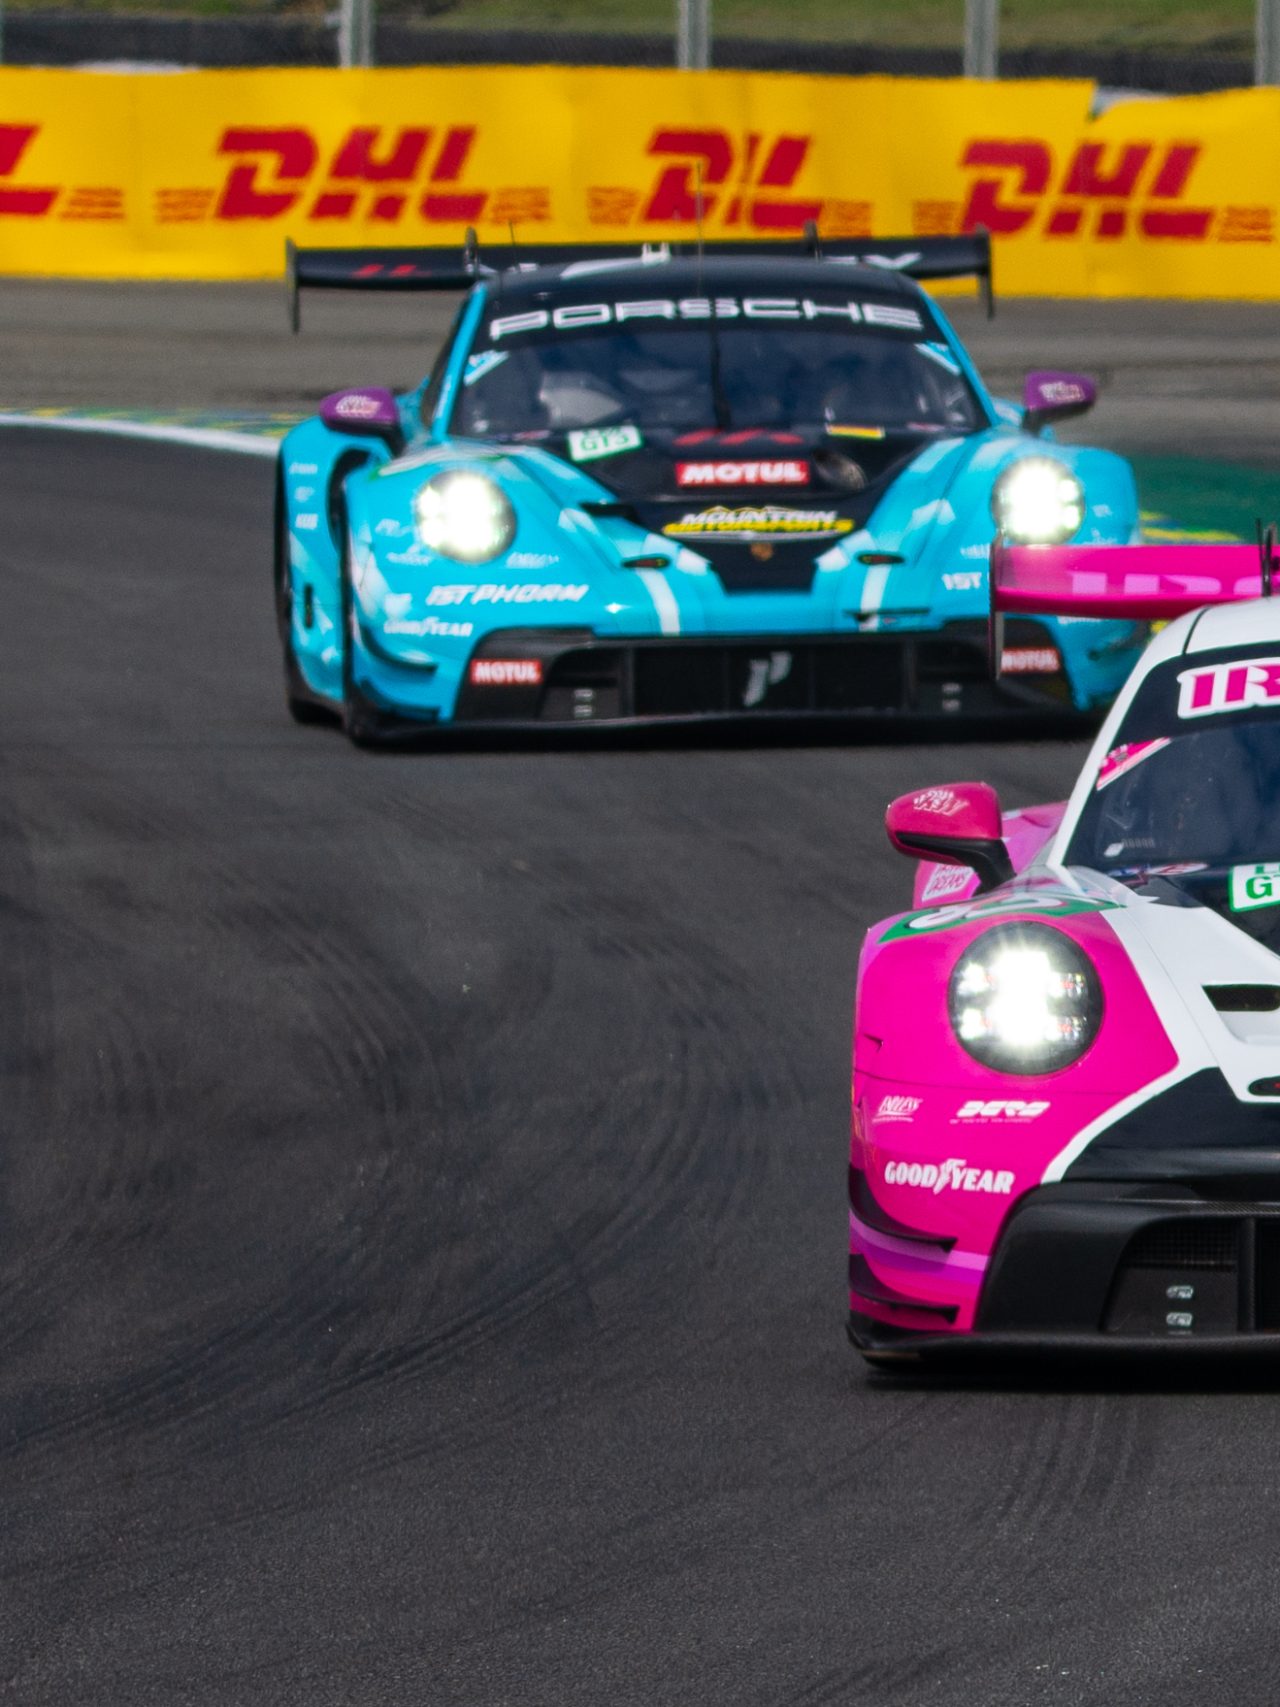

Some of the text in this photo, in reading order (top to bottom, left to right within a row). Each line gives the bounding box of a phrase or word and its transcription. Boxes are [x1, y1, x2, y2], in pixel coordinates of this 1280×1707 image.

[214, 125, 489, 222] DHL
[959, 138, 1213, 240] DHL
[490, 298, 923, 341] PORSCHE
[681, 461, 806, 484] MOTUL
[473, 661, 538, 682] MOTUL
[884, 1158, 1016, 1195] GOODYEAR
